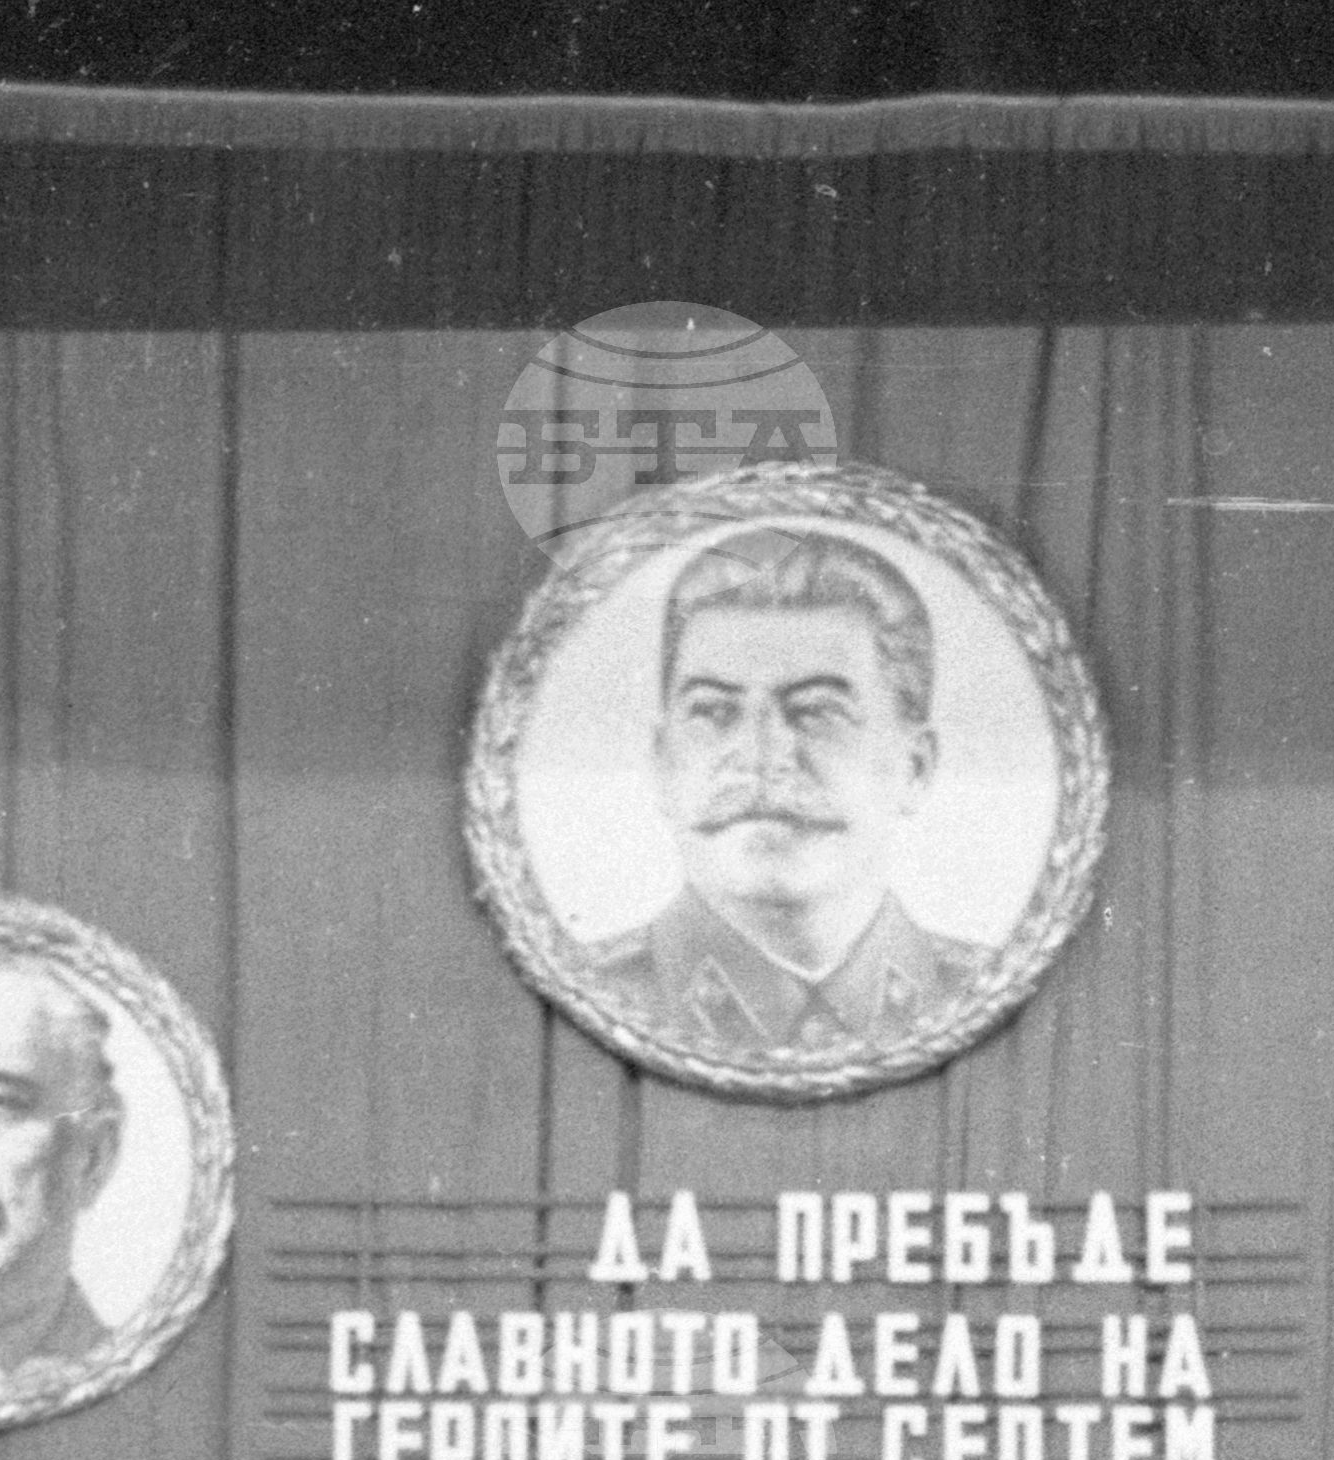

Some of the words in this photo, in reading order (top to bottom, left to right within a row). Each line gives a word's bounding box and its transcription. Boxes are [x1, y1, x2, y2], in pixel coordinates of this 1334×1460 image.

[588, 1188, 712, 1283] ДА
[777, 1189, 1193, 1284] ПРЕБЪДЕ
[328, 1309, 761, 1397] СЛАВНОТО
[802, 1310, 1042, 1398] ДЕЛО
[1101, 1312, 1213, 1399] НА
